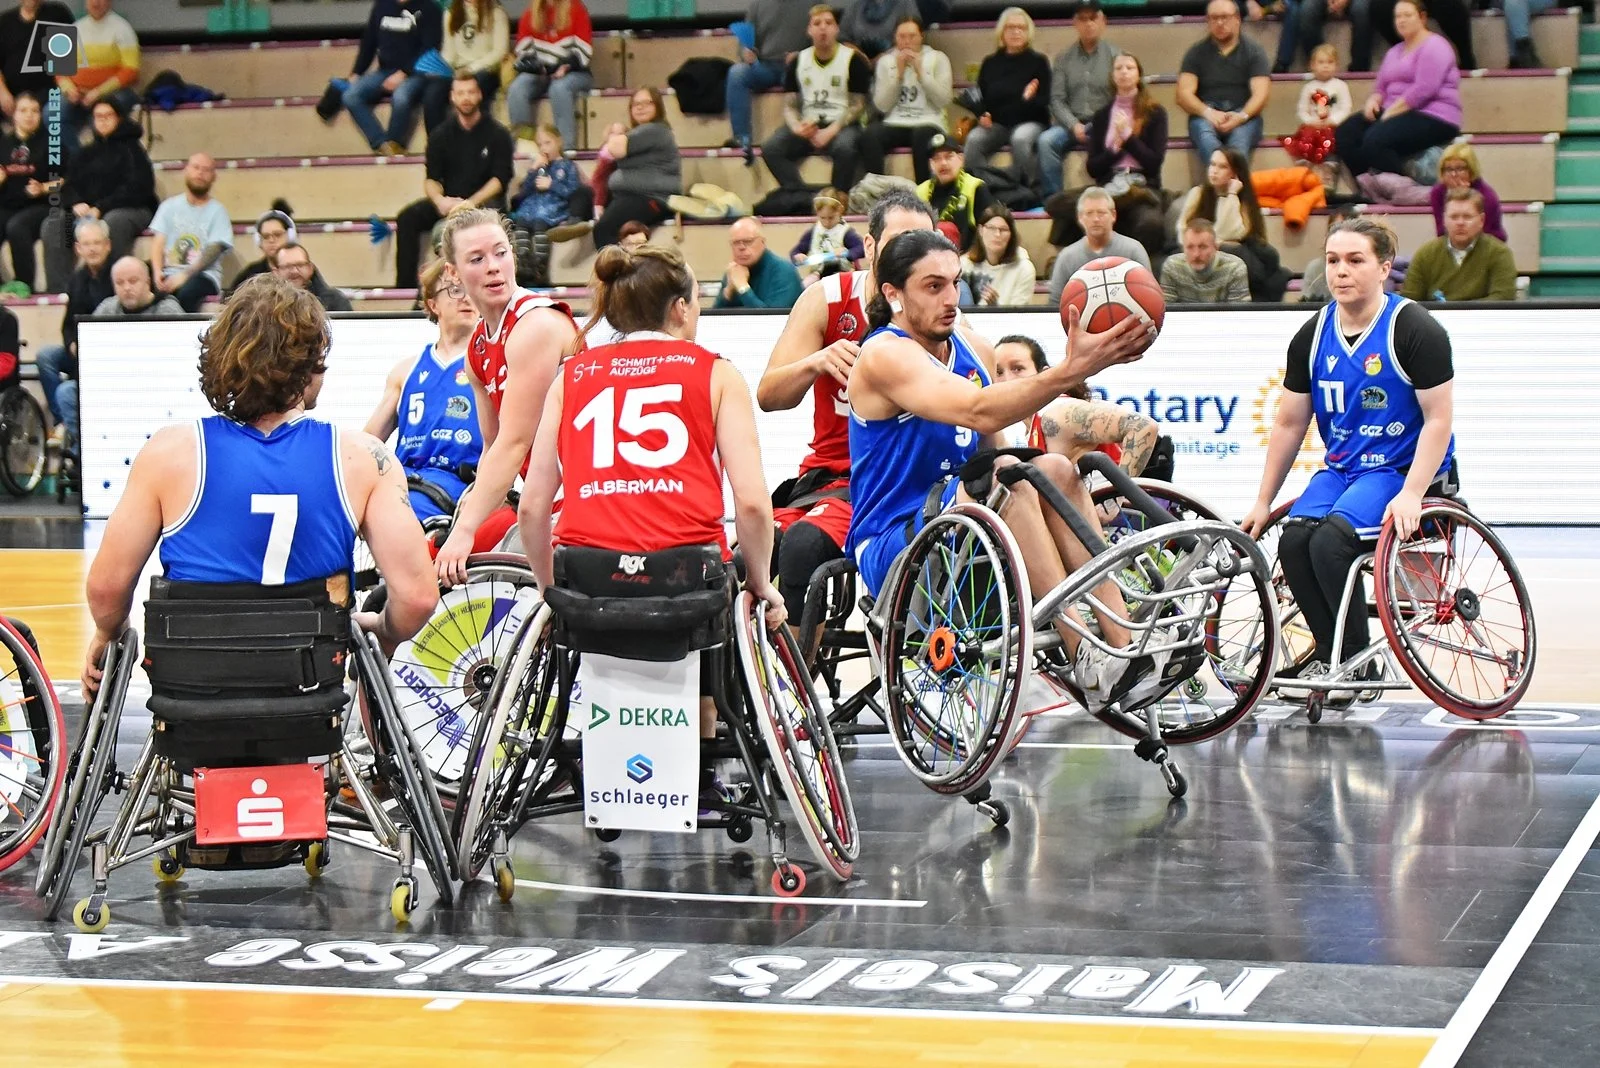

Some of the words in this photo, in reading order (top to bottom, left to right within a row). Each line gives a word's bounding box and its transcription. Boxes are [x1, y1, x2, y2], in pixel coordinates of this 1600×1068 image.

[608, 365, 658, 377] AUFZÜGE
[1318, 379, 1345, 413] 11
[408, 392, 425, 426] 5
[431, 428, 454, 441] GGZ
[572, 383, 690, 469] 15
[1359, 424, 1384, 437] GGZ
[1360, 451, 1385, 463] eins
[579, 478, 685, 500] SILBERMAN
[250, 493, 298, 586] 7
[619, 707, 690, 727] DEKRA
[590, 788, 690, 810] schlaeger
[204, 938, 688, 994] Weisse
[709, 955, 1287, 1016] Maisel's
